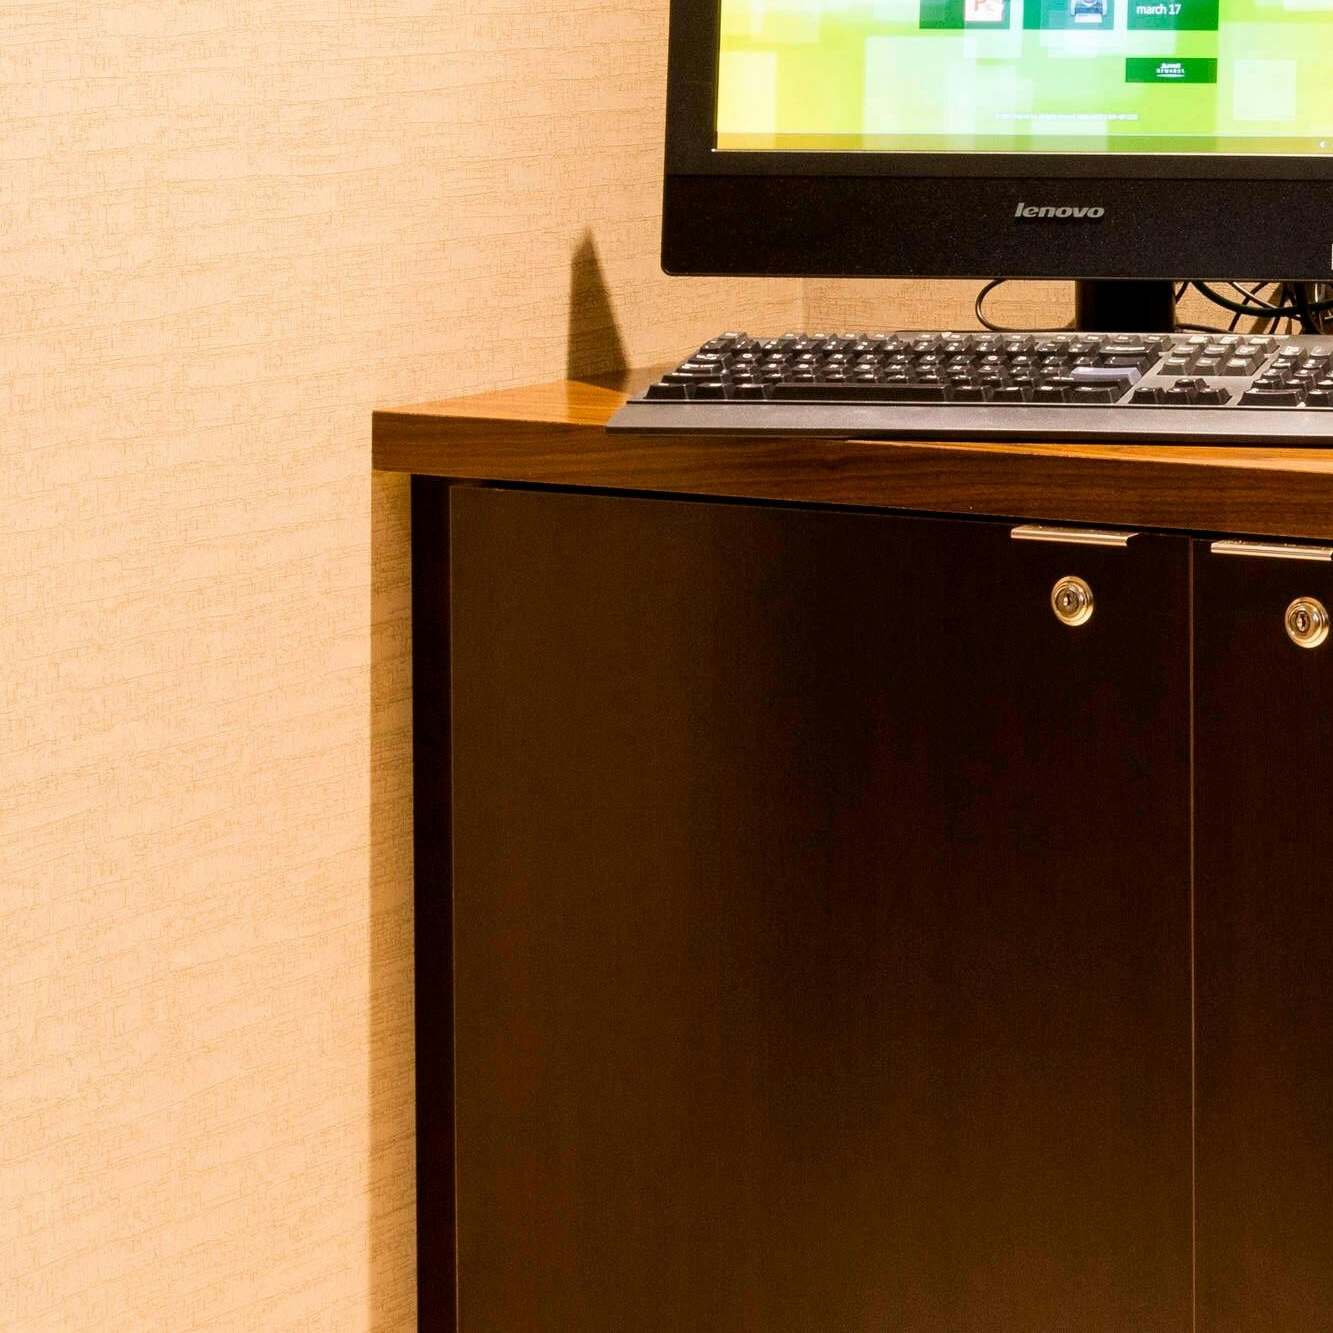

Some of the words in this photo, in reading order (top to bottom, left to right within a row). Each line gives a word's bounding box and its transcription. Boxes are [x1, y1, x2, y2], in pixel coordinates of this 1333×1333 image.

[1136, 4, 1167, 15] march
[1168, 4, 1182, 15] 17
[1014, 202, 1105, 218] lenovo
